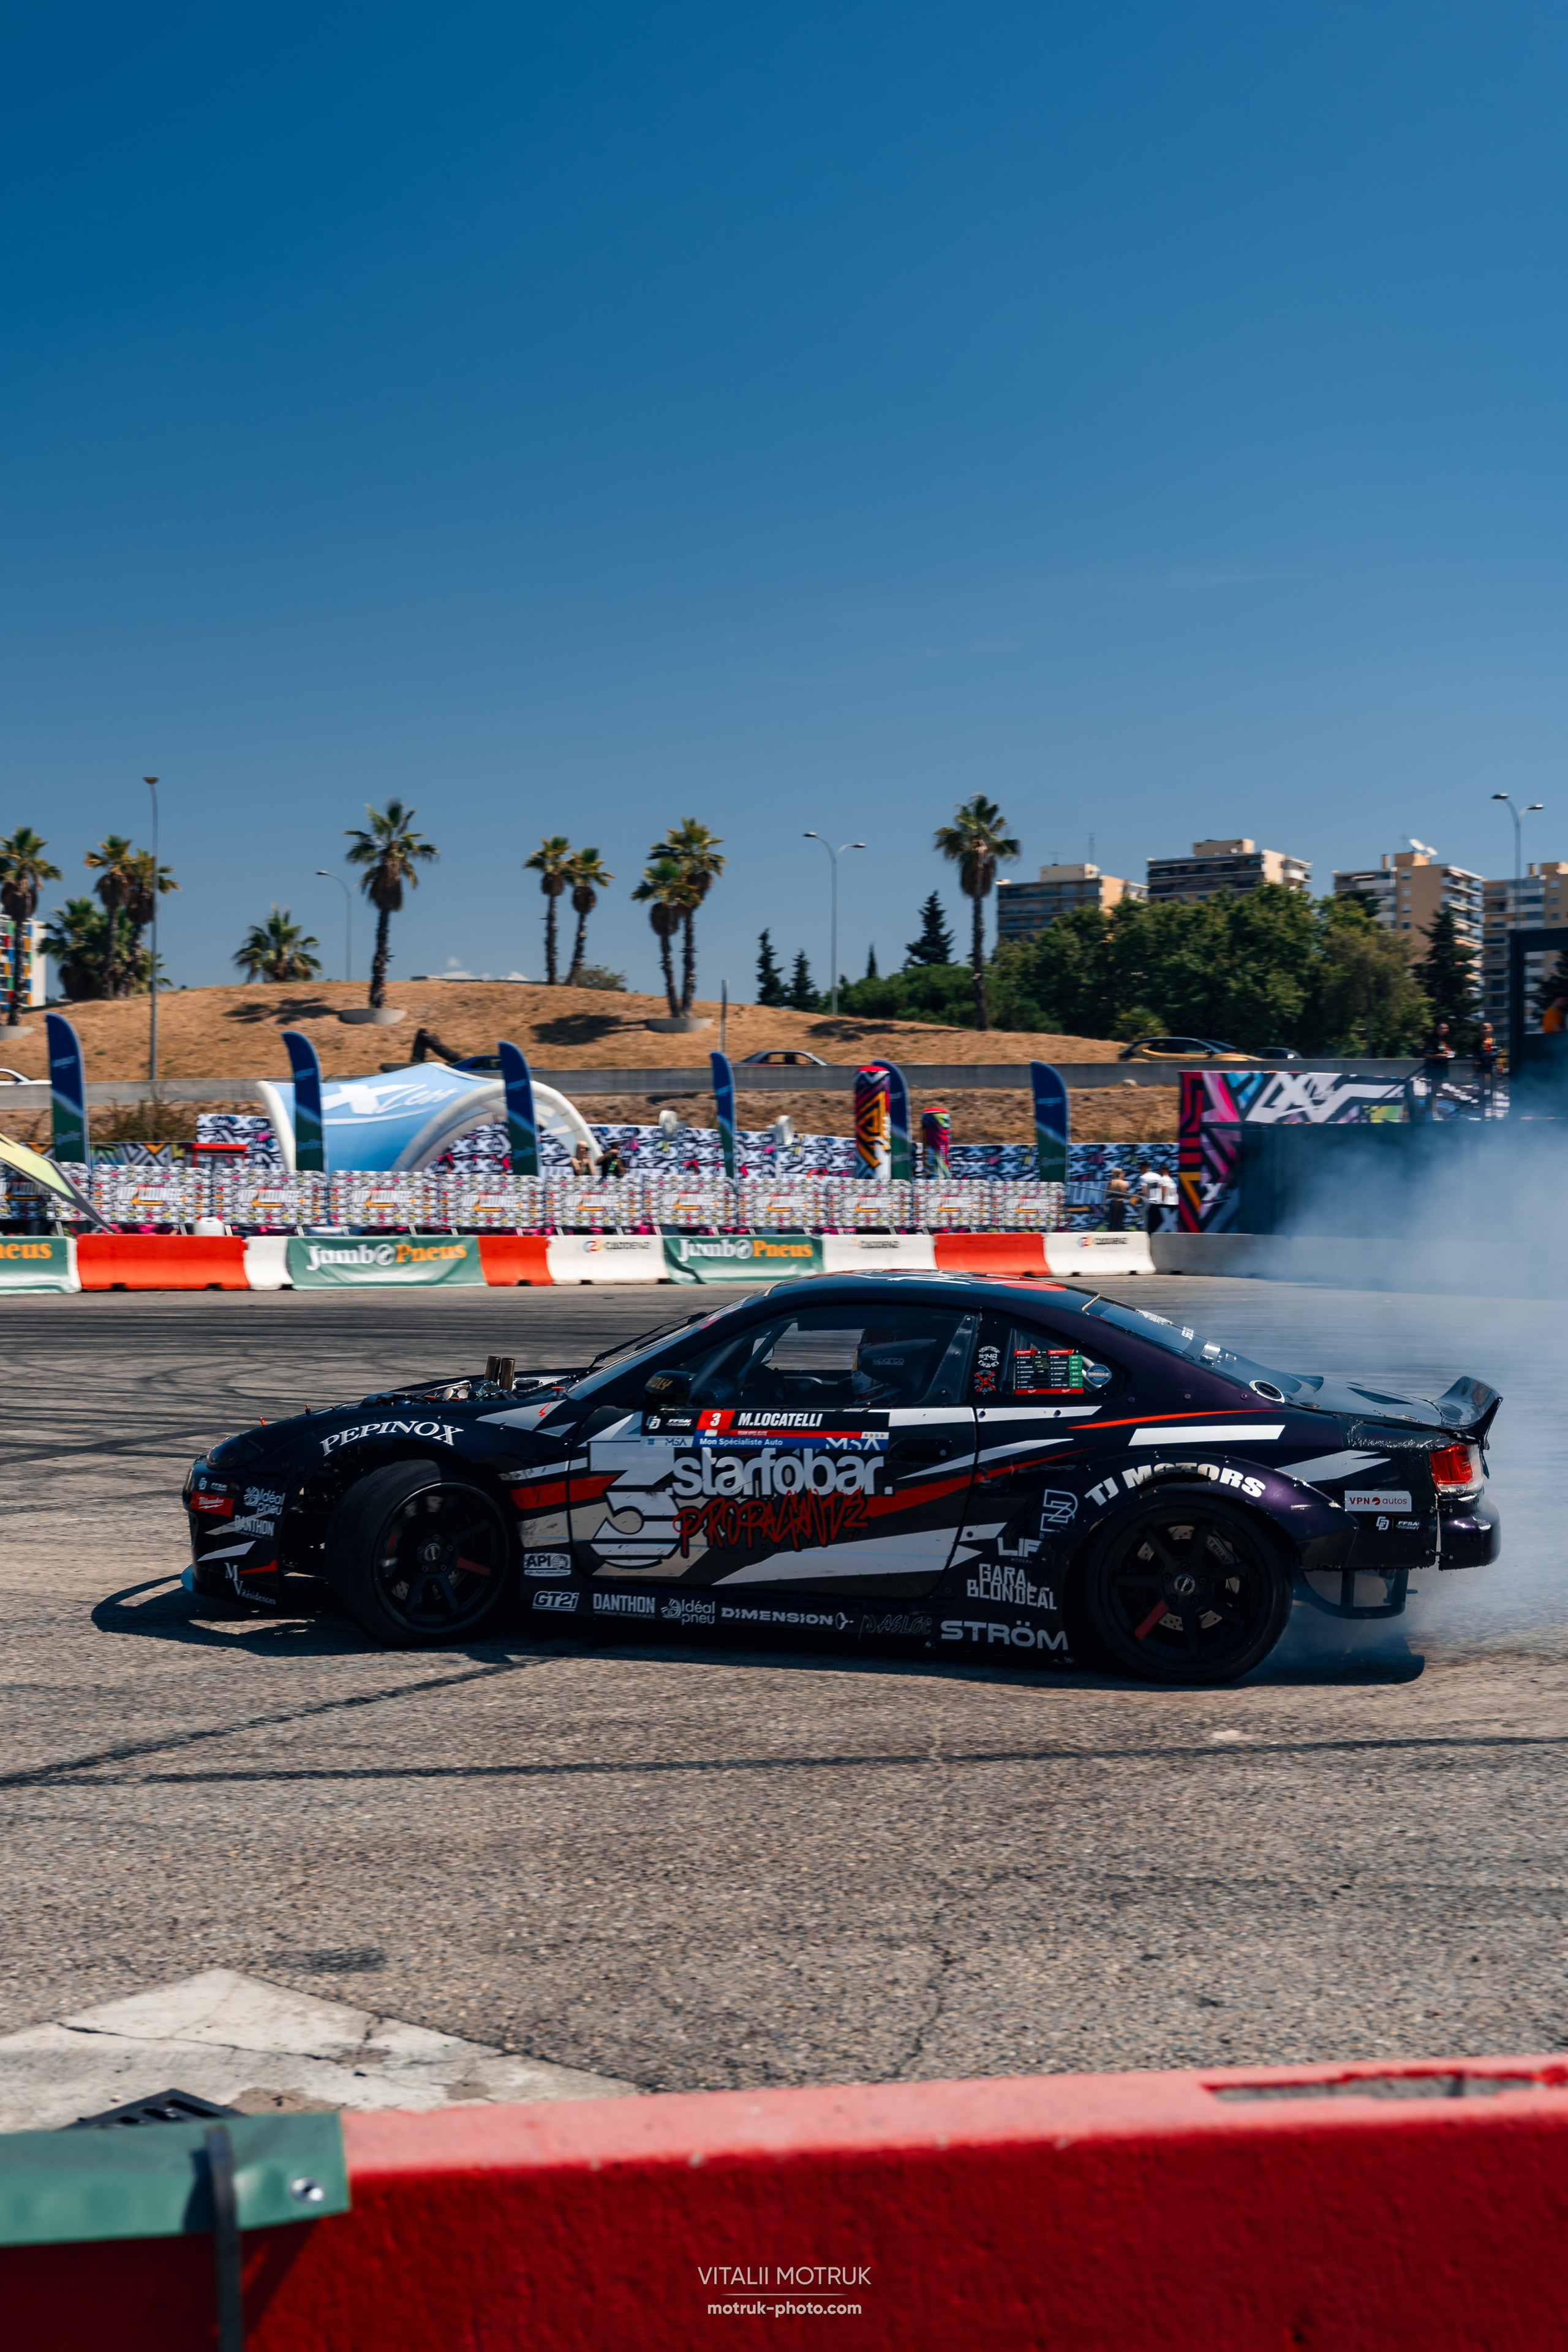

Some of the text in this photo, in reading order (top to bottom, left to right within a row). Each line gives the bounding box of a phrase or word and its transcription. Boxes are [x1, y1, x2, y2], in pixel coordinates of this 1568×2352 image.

[710, 1412, 722, 1427] 3
[737, 1412, 823, 1427] M.LOCATELLI
[319, 1420, 464, 1457] PEPINOX
[258, 1488, 286, 1506] Idéal
[1084, 1476, 1120, 1507] TJ
[256, 1502, 283, 1516] pneu
[527, 1555, 551, 1567] API
[593, 1593, 656, 1614] DANTHON
[682, 1599, 715, 1615] Idéal
[681, 1613, 715, 1626] pneu
[721, 1607, 834, 1625] DIMENSION
[940, 1620, 1069, 1651] STRÖM
